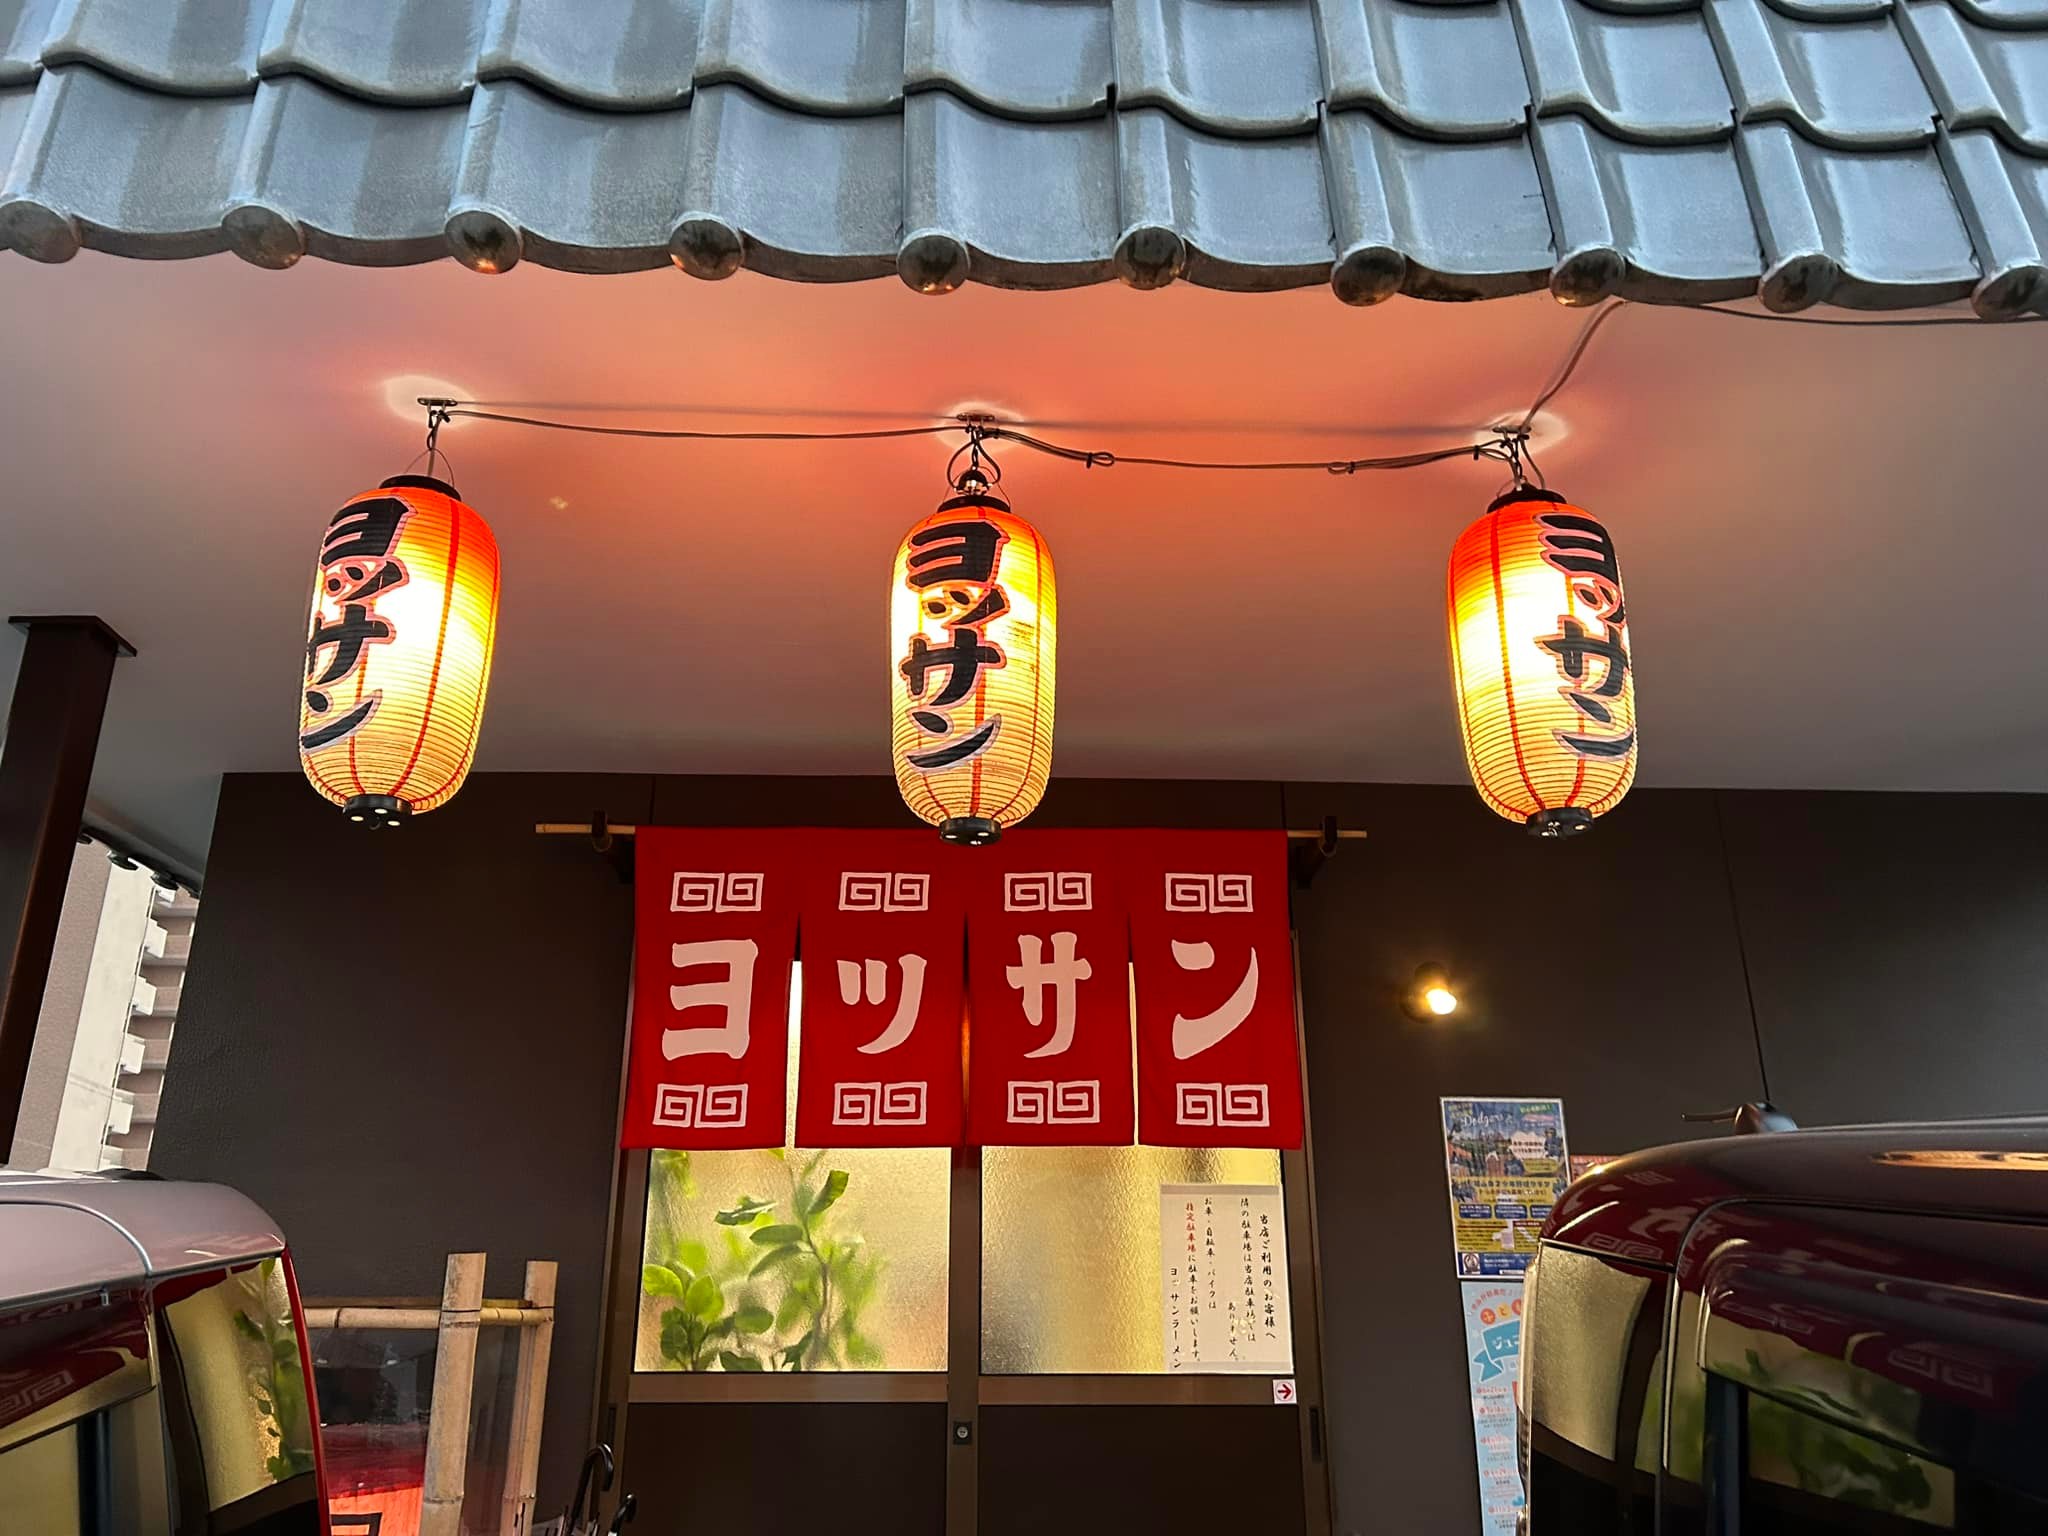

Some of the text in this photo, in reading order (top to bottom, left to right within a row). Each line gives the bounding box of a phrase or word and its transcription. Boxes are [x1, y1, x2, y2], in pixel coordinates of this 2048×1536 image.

[301, 496, 417, 754] ヨッサン
[898, 518, 1010, 772] ヨッサン
[1532, 512, 1635, 761] ヨッサン
[662, 931, 1260, 1061] ヨッサン
[1259, 1213, 1276, 1339] 当店ご利用のお客様へ
